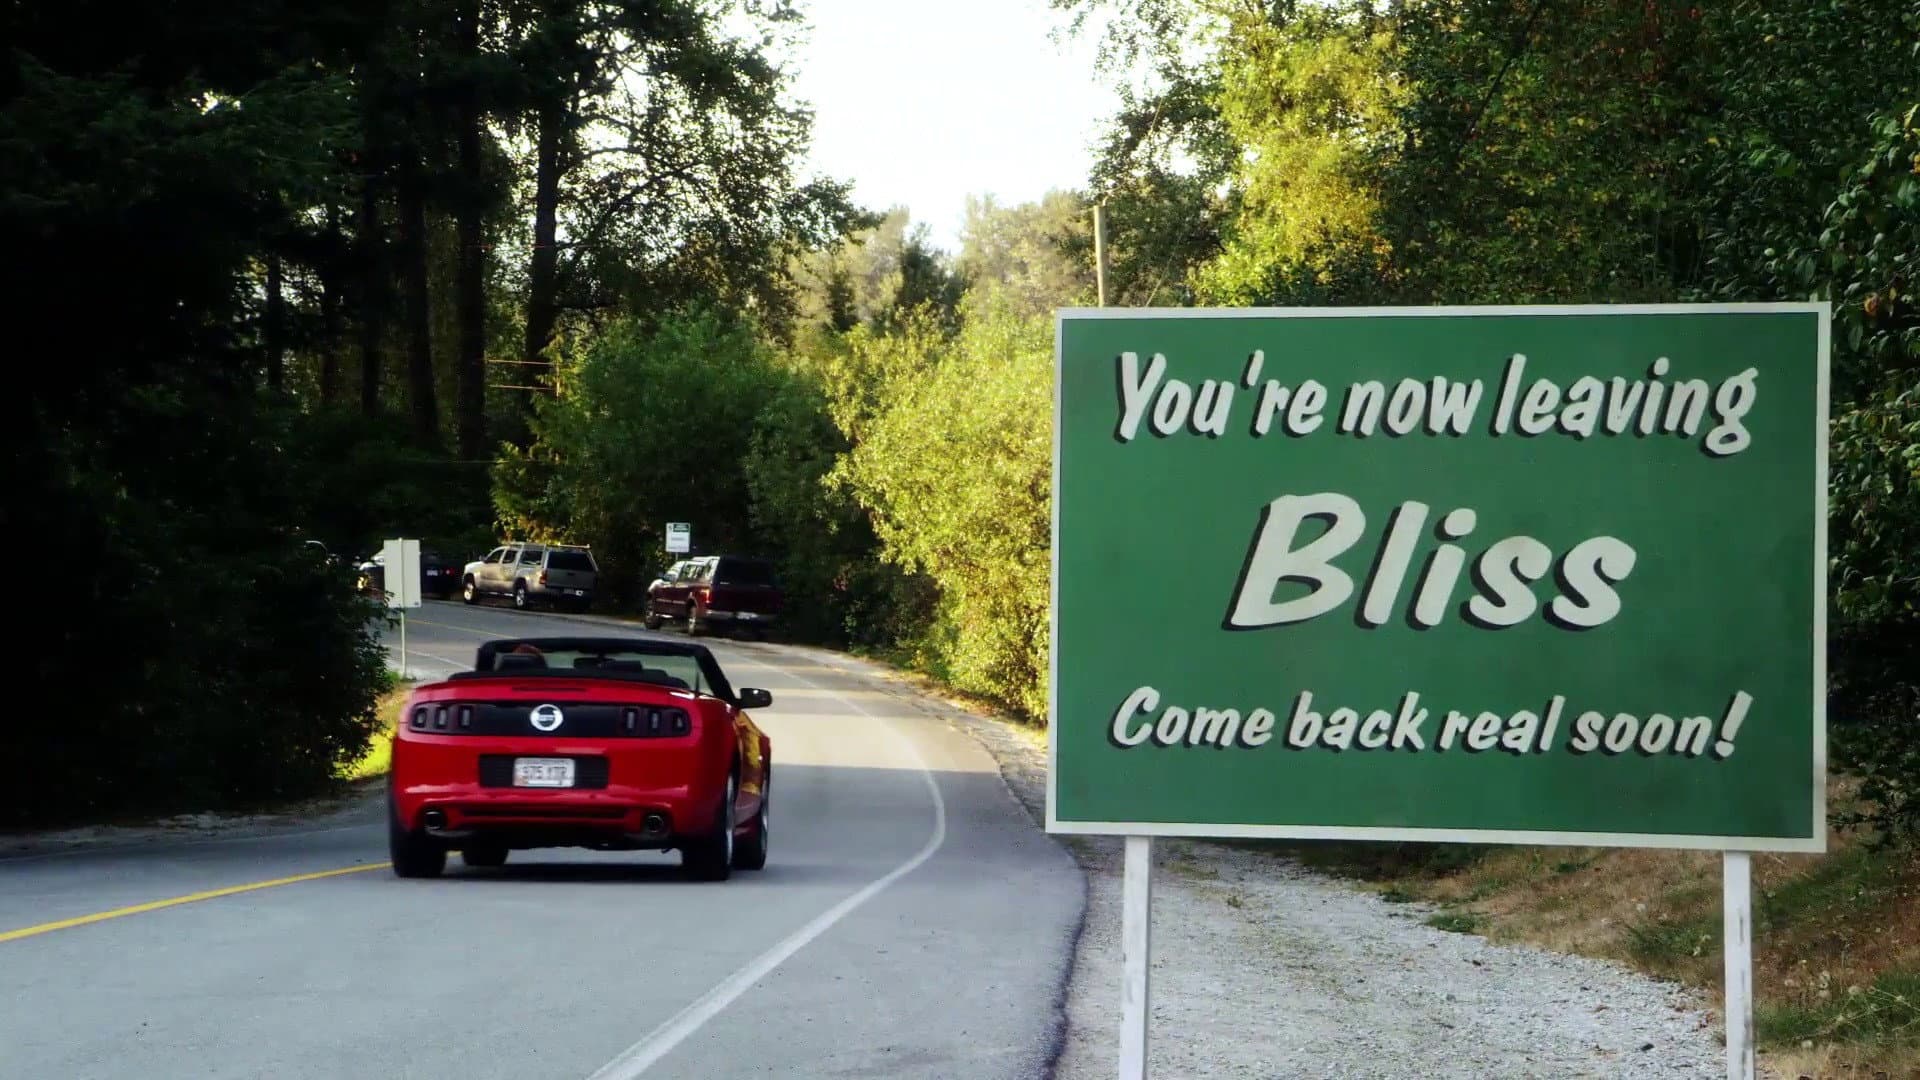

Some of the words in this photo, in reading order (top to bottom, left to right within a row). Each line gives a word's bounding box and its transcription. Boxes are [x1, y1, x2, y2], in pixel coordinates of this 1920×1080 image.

[1117, 348, 1328, 442] You're
[1340, 375, 1484, 437] now
[1493, 353, 1760, 456] leaving
[1226, 490, 1638, 630] Bliss
[1111, 685, 1277, 748] Come
[1287, 690, 1430, 751] back
[1437, 695, 1567, 754] real
[1570, 690, 1754, 759] soon!
